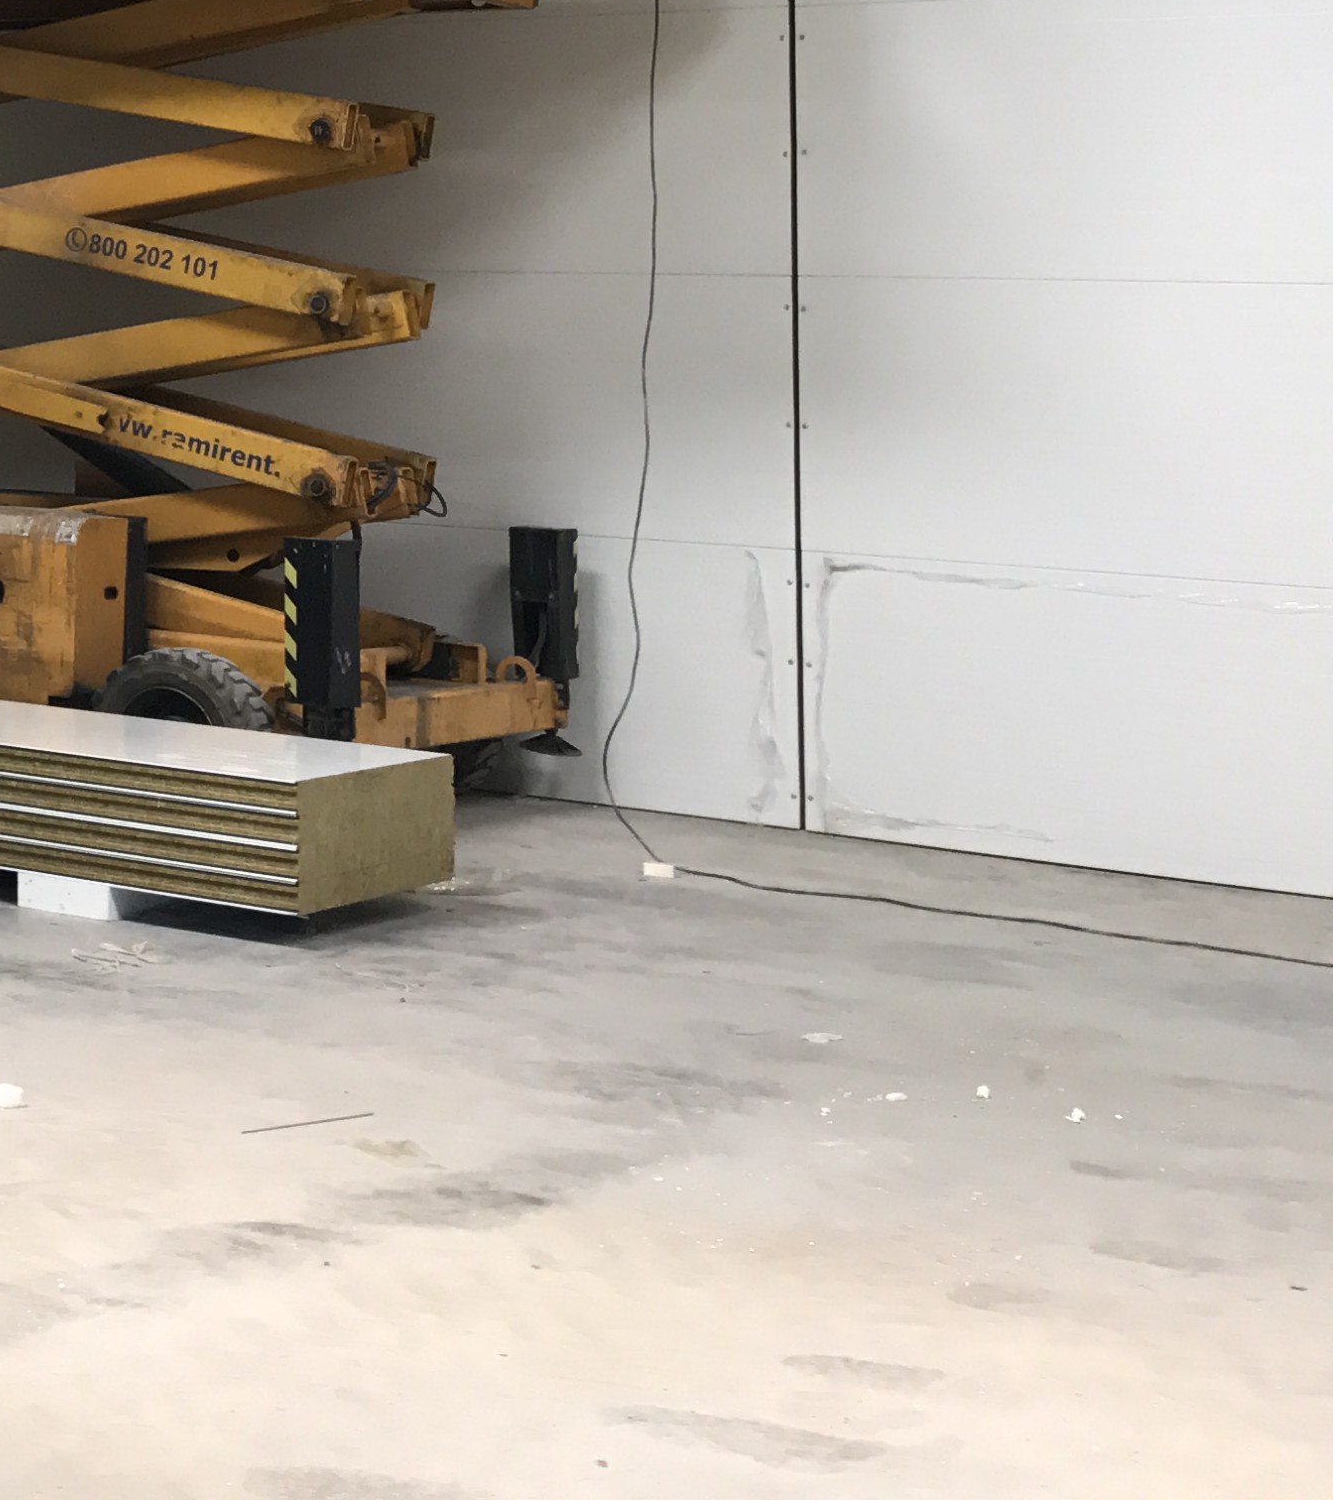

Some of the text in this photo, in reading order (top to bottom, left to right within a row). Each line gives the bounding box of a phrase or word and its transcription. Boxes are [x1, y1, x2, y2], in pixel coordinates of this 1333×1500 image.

[88, 234, 218, 280] 800 202 101
